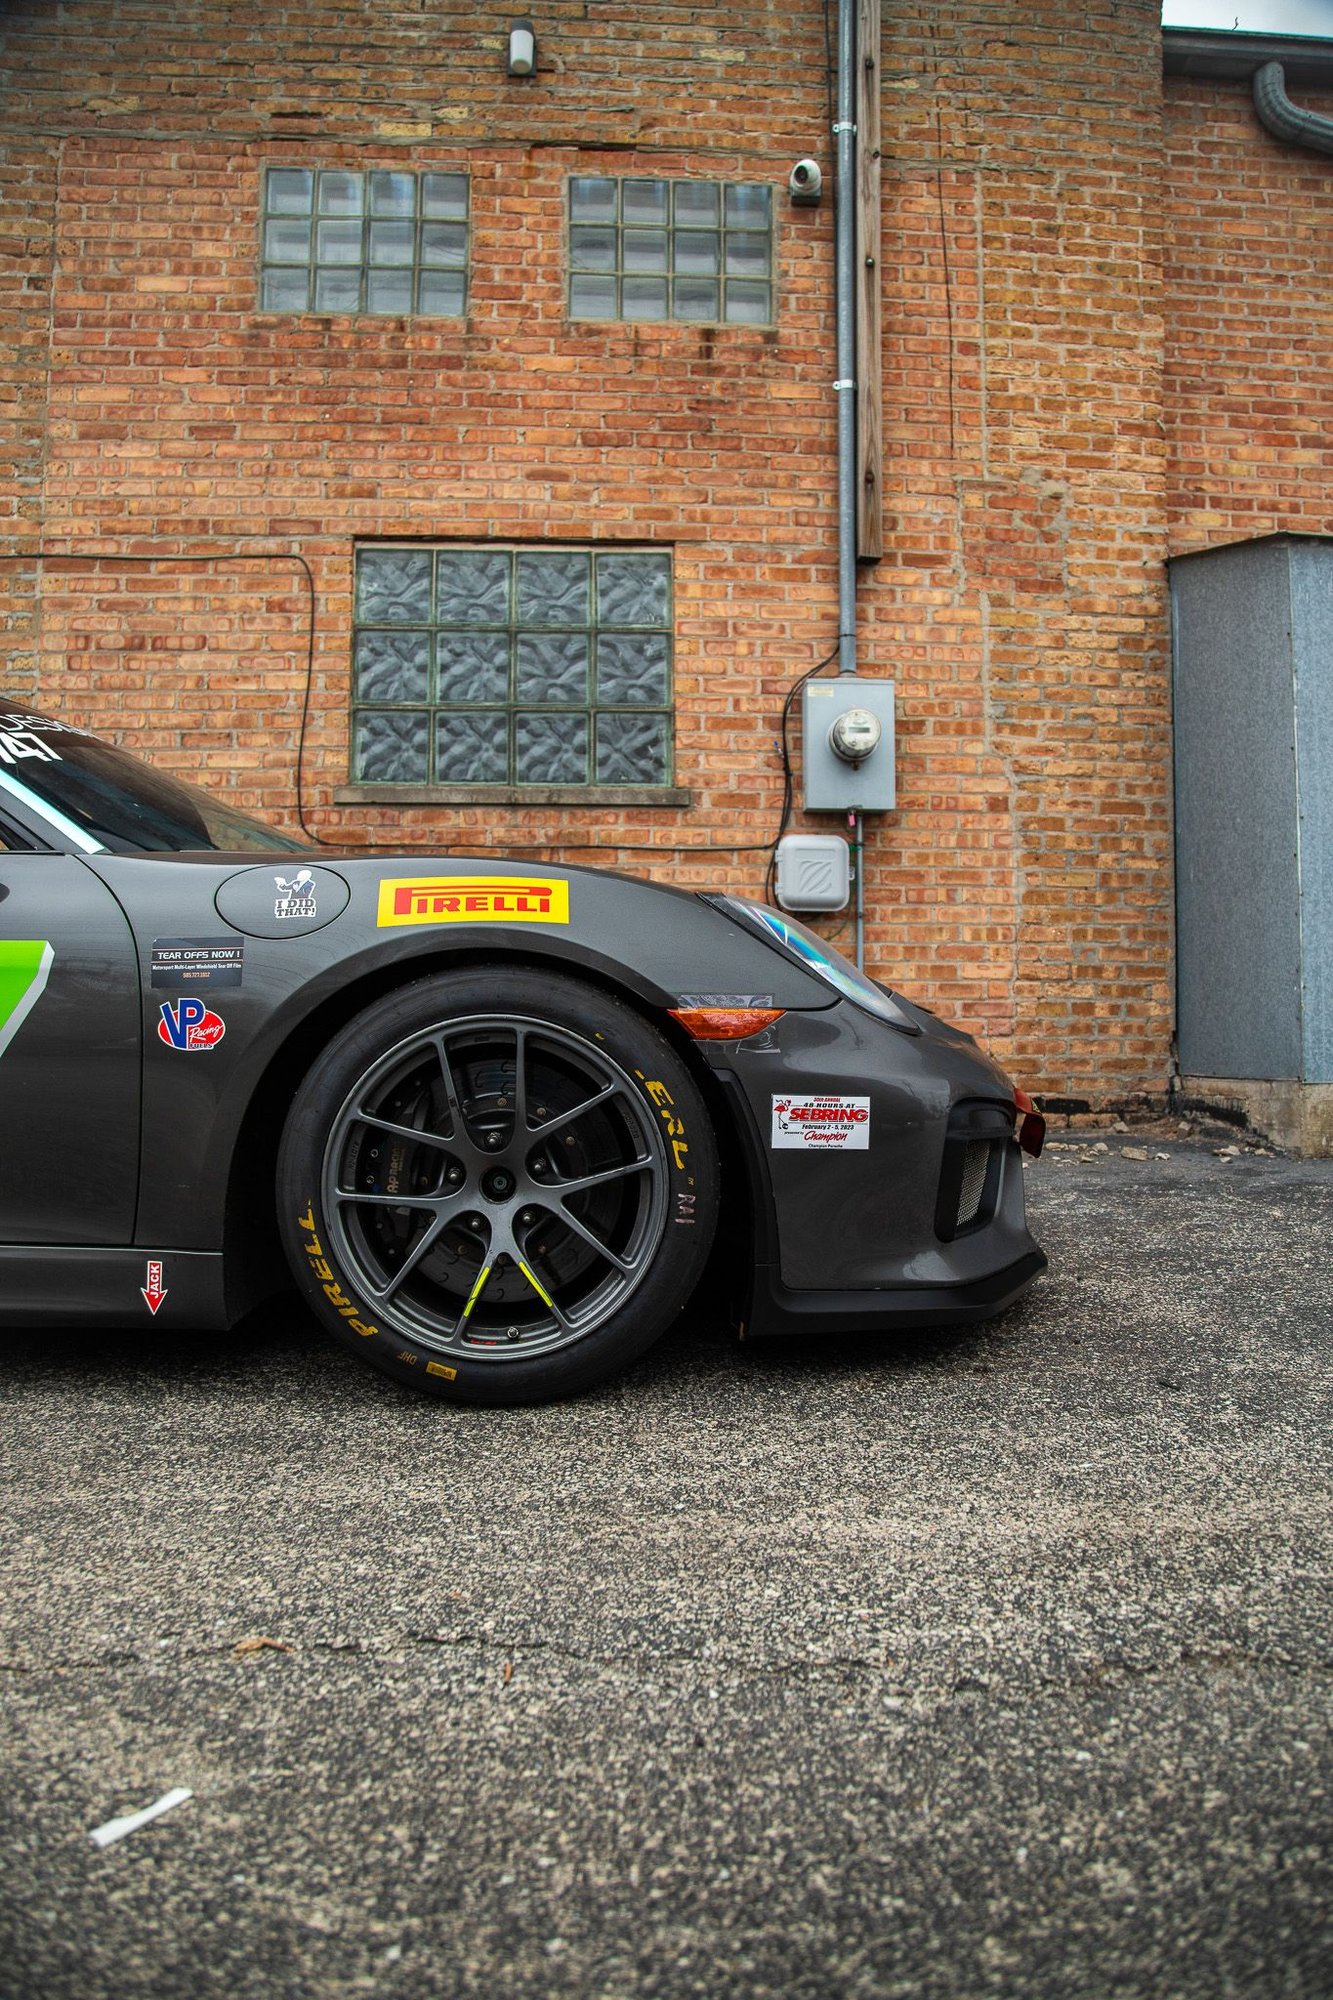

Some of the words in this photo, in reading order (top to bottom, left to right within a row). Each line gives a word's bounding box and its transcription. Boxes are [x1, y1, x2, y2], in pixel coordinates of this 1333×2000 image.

[287, 900, 314, 908] DID
[394, 886, 553, 915] PIRELLI
[276, 907, 315, 917] THAT!
[158, 952, 182, 960] TEAR
[184, 951, 209, 959] OFFS
[211, 950, 235, 958] NOW
[160, 998, 206, 1050] VP
[189, 1024, 224, 1043] Racing
[788, 1108, 868, 1122] SEBRING
[804, 1131, 848, 1143] Champion
[298, 1200, 379, 1337] PIRELL
[150, 1264, 160, 1299] JACK
